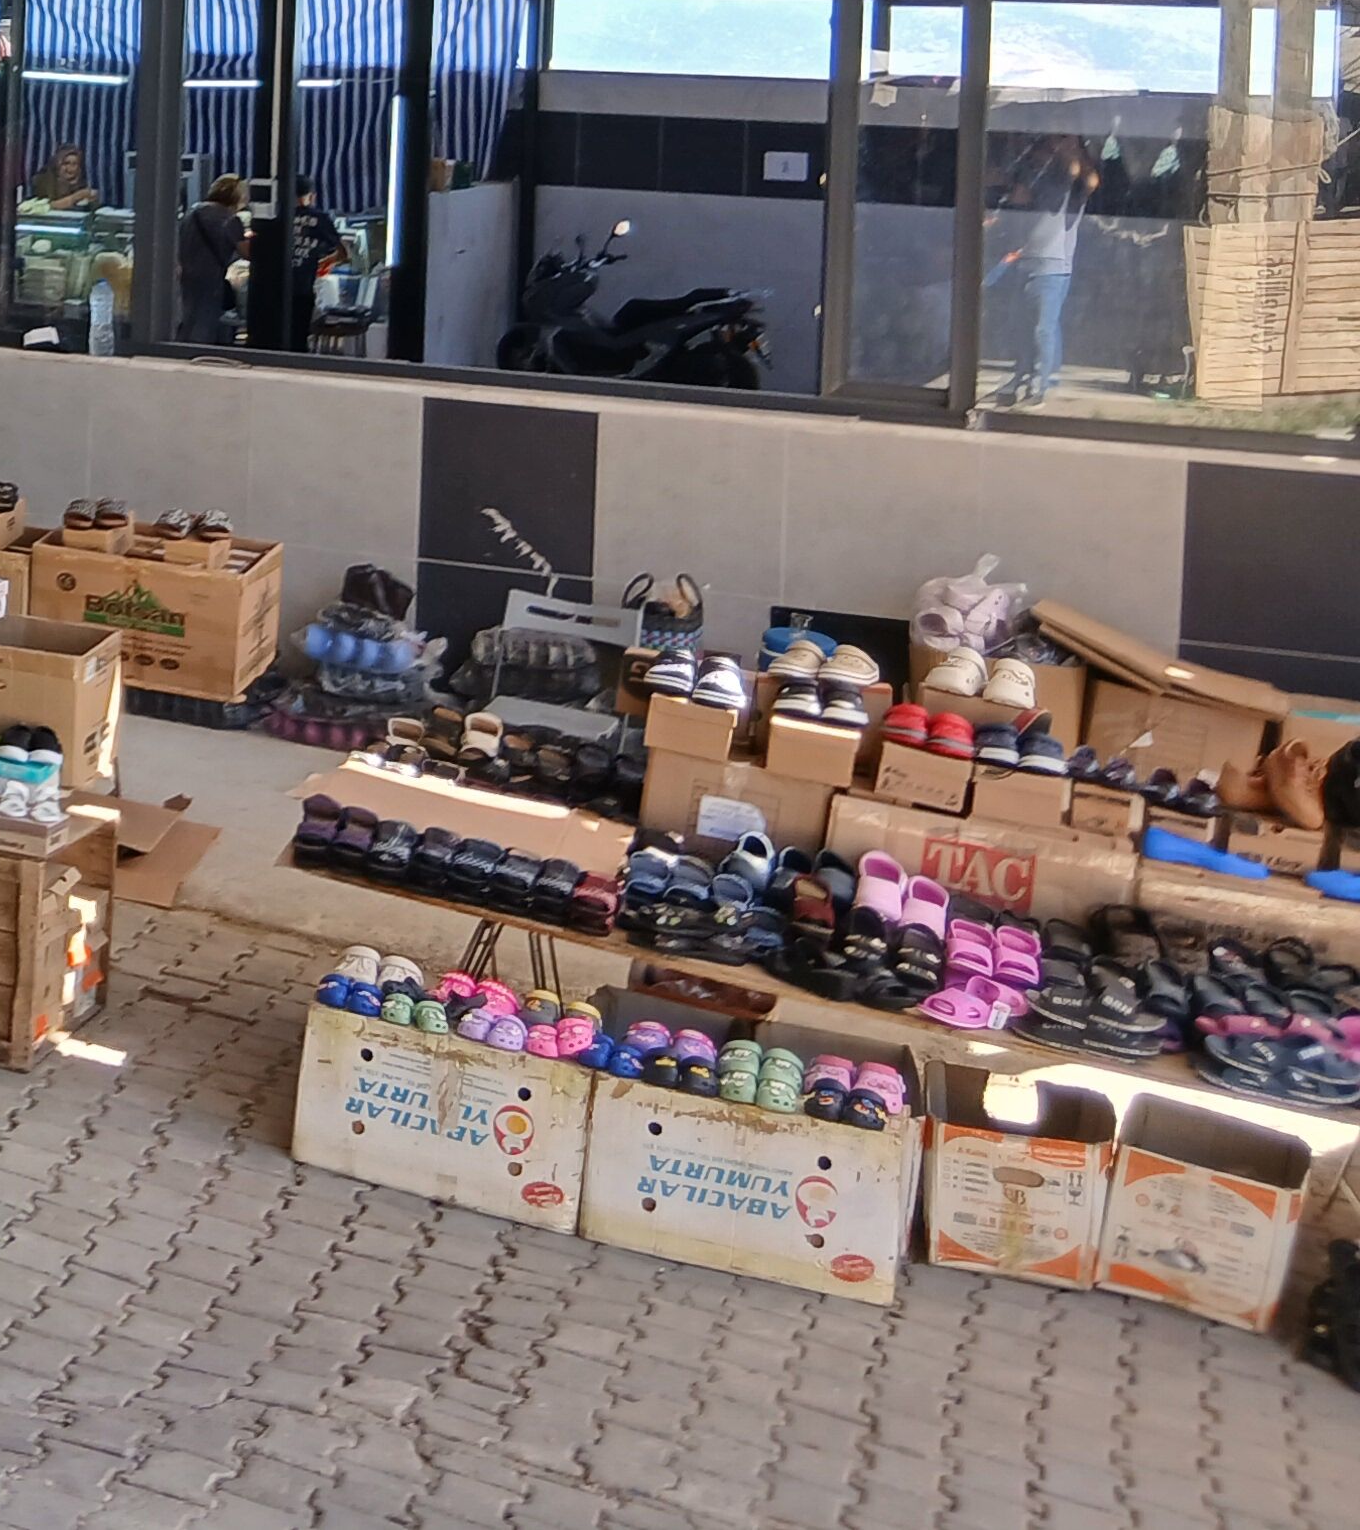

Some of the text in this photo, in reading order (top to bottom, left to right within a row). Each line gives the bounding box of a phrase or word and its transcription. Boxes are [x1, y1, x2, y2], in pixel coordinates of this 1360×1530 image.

[358, 1077, 489, 1125] YUURTA
[637, 1175, 792, 1220] ABACILAR
[649, 1154, 790, 1198] YUMURTA
